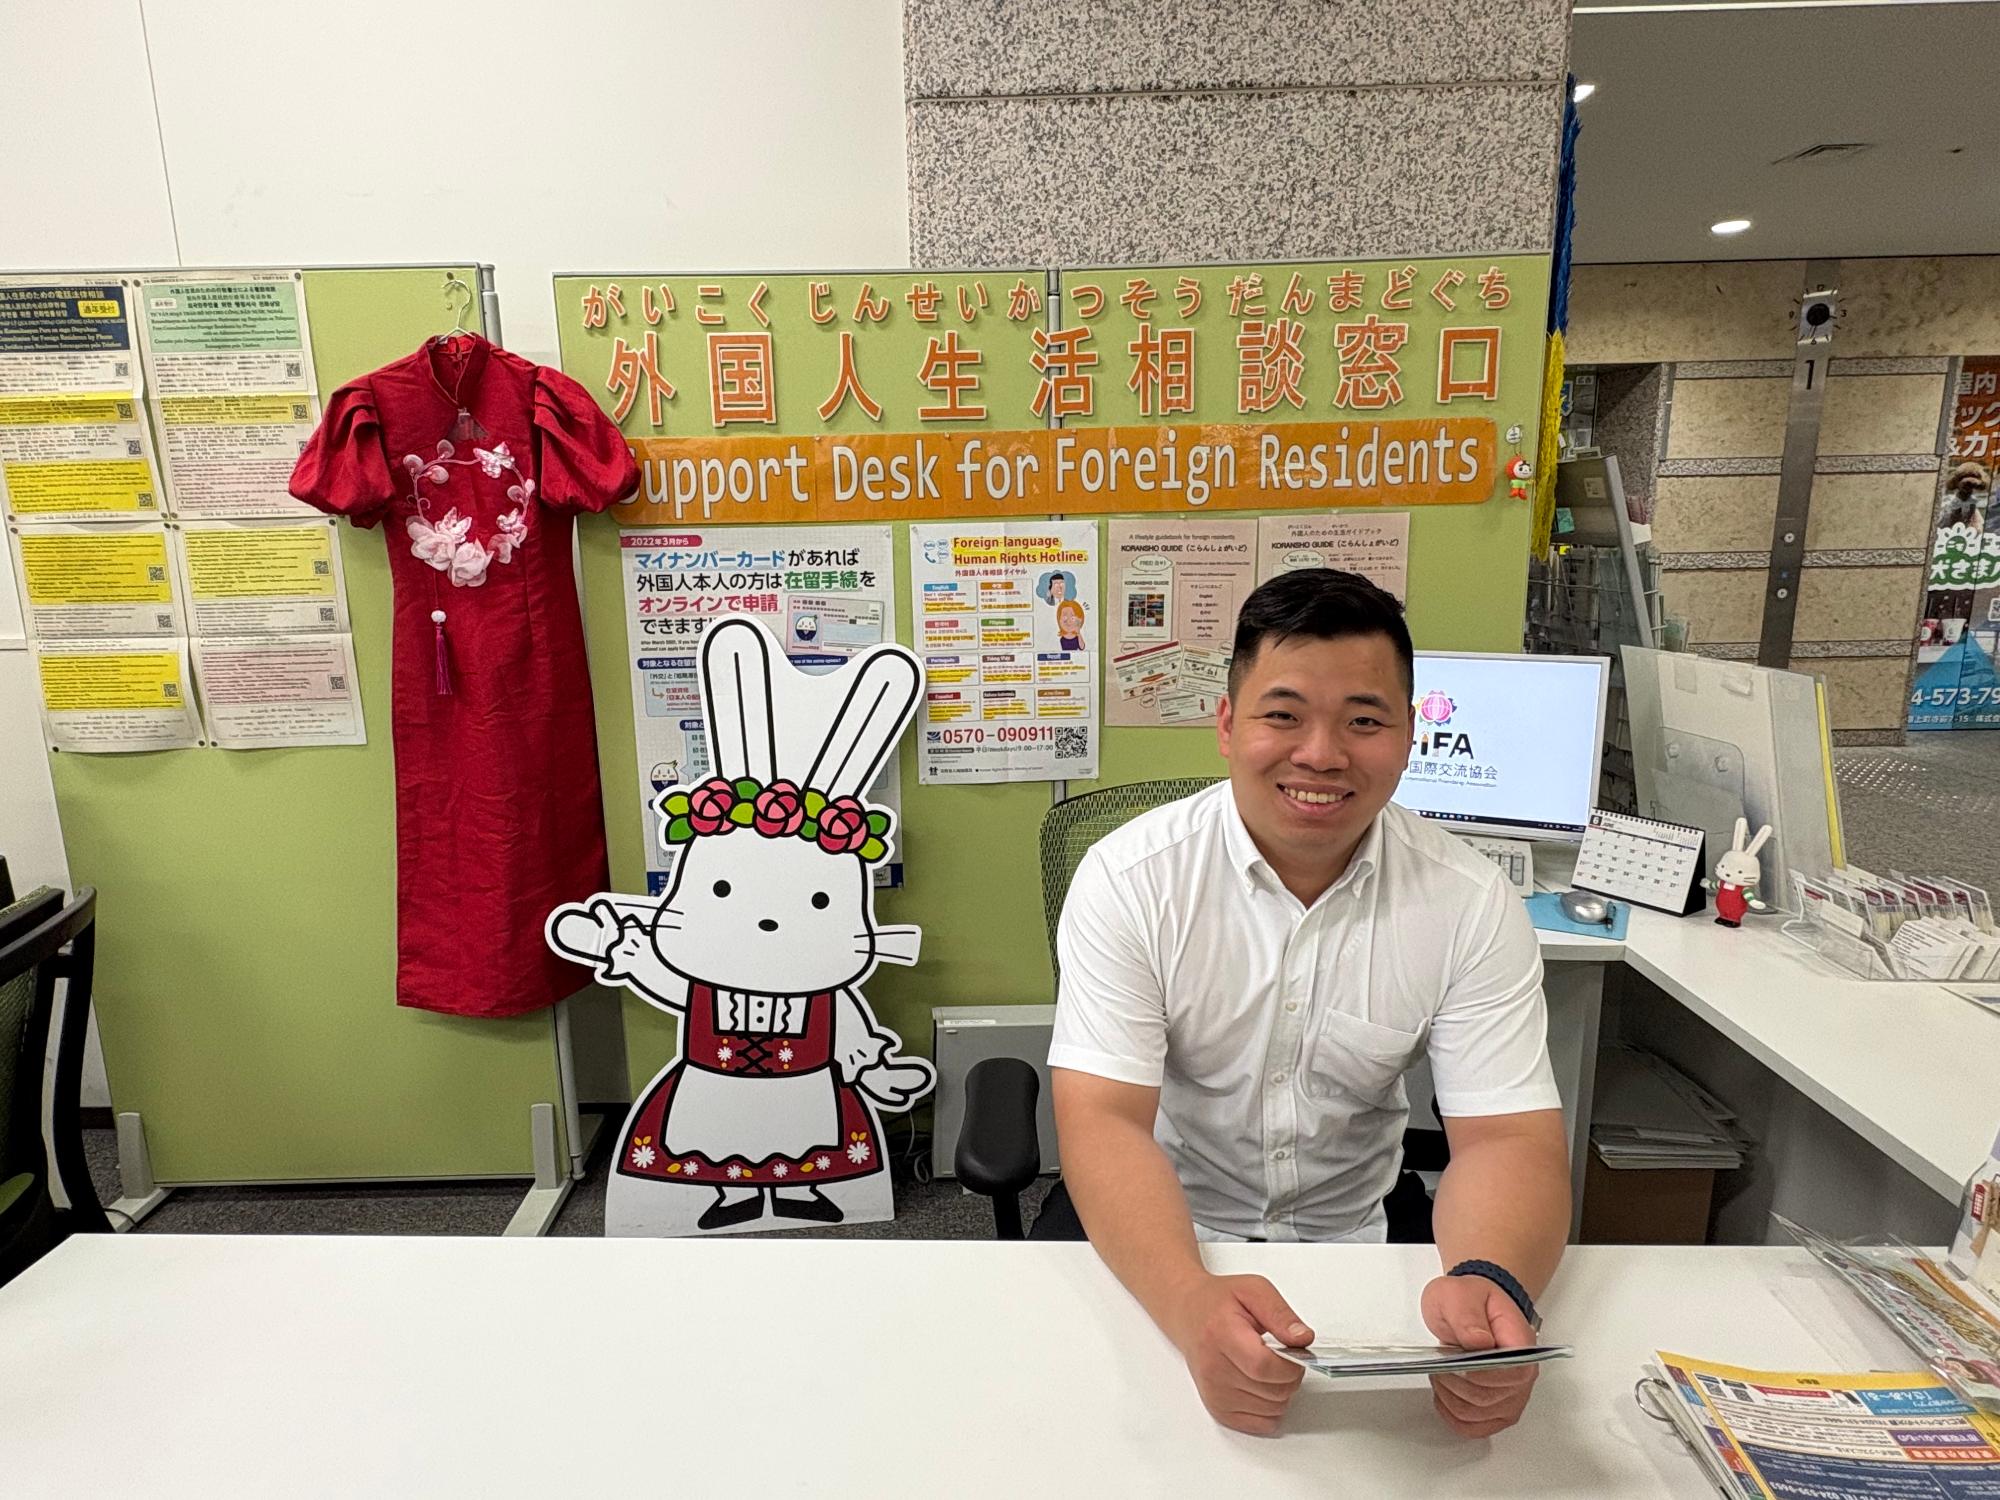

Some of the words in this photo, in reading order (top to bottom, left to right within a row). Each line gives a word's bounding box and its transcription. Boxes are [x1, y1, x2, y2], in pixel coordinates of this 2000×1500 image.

[606, 313, 1502, 428] 外国人生活相談窓口
[1805, 359, 1815, 389] 1
[620, 446, 810, 520] upport
[832, 439, 941, 500] Desk
[956, 439, 1039, 500] for
[1056, 429, 1237, 506] Foreign
[1259, 425, 1479, 490] Residents
[631, 536, 689, 547] 2022年3月から
[1121, 544, 1160, 552] KORANSHO
[1161, 544, 1184, 552] GUIDE
[1271, 541, 1310, 549] KORANSHO
[1311, 540, 1335, 548] GUIDE
[635, 549, 860, 569] マイナンバーカードがあれば
[954, 553, 997, 565] Human
[999, 551, 1037, 567] Rights
[637, 570, 876, 592] 外国人本人の方は在留手続を
[639, 593, 778, 614] オンラインで申請
[1409, 760, 1498, 781] 国際交流協会
[1592, 815, 1599, 825] 6
